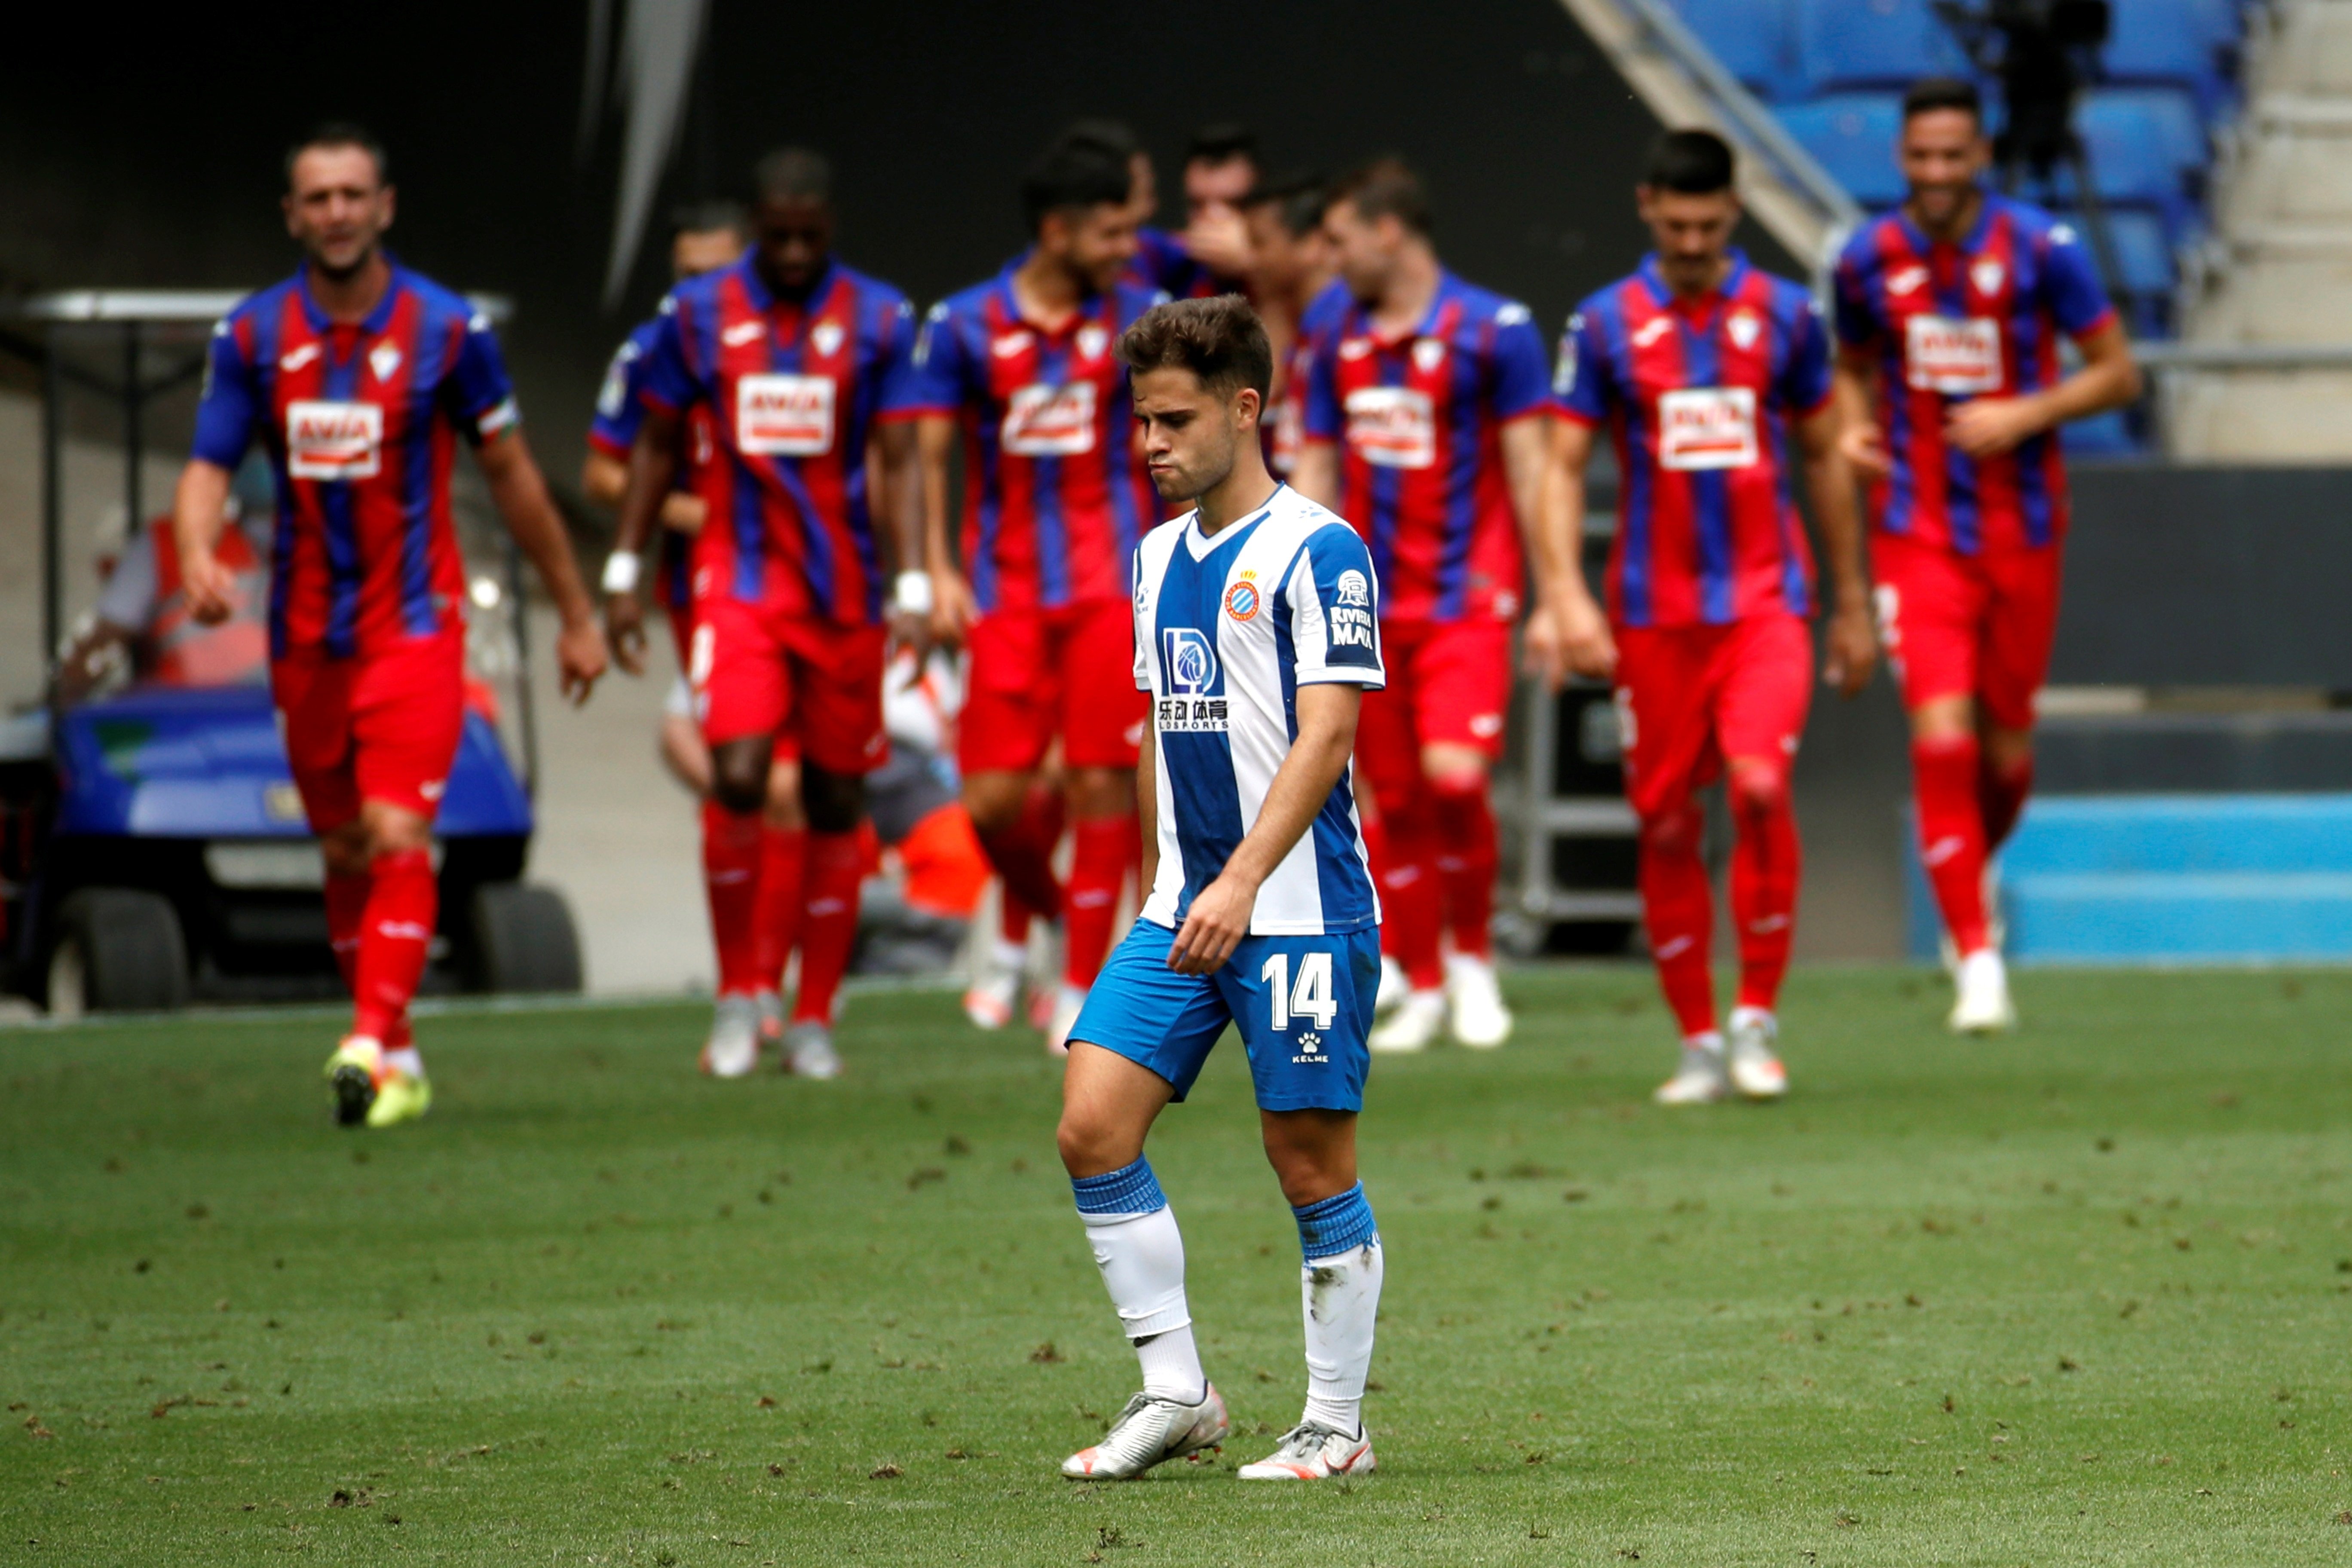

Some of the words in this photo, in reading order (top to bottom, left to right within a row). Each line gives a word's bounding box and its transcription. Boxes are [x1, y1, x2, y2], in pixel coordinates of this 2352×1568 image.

[1159, 700, 1228, 720] 乐动体育
[1262, 952, 1337, 1030] 14
[1292, 1055, 1329, 1063] KELME
